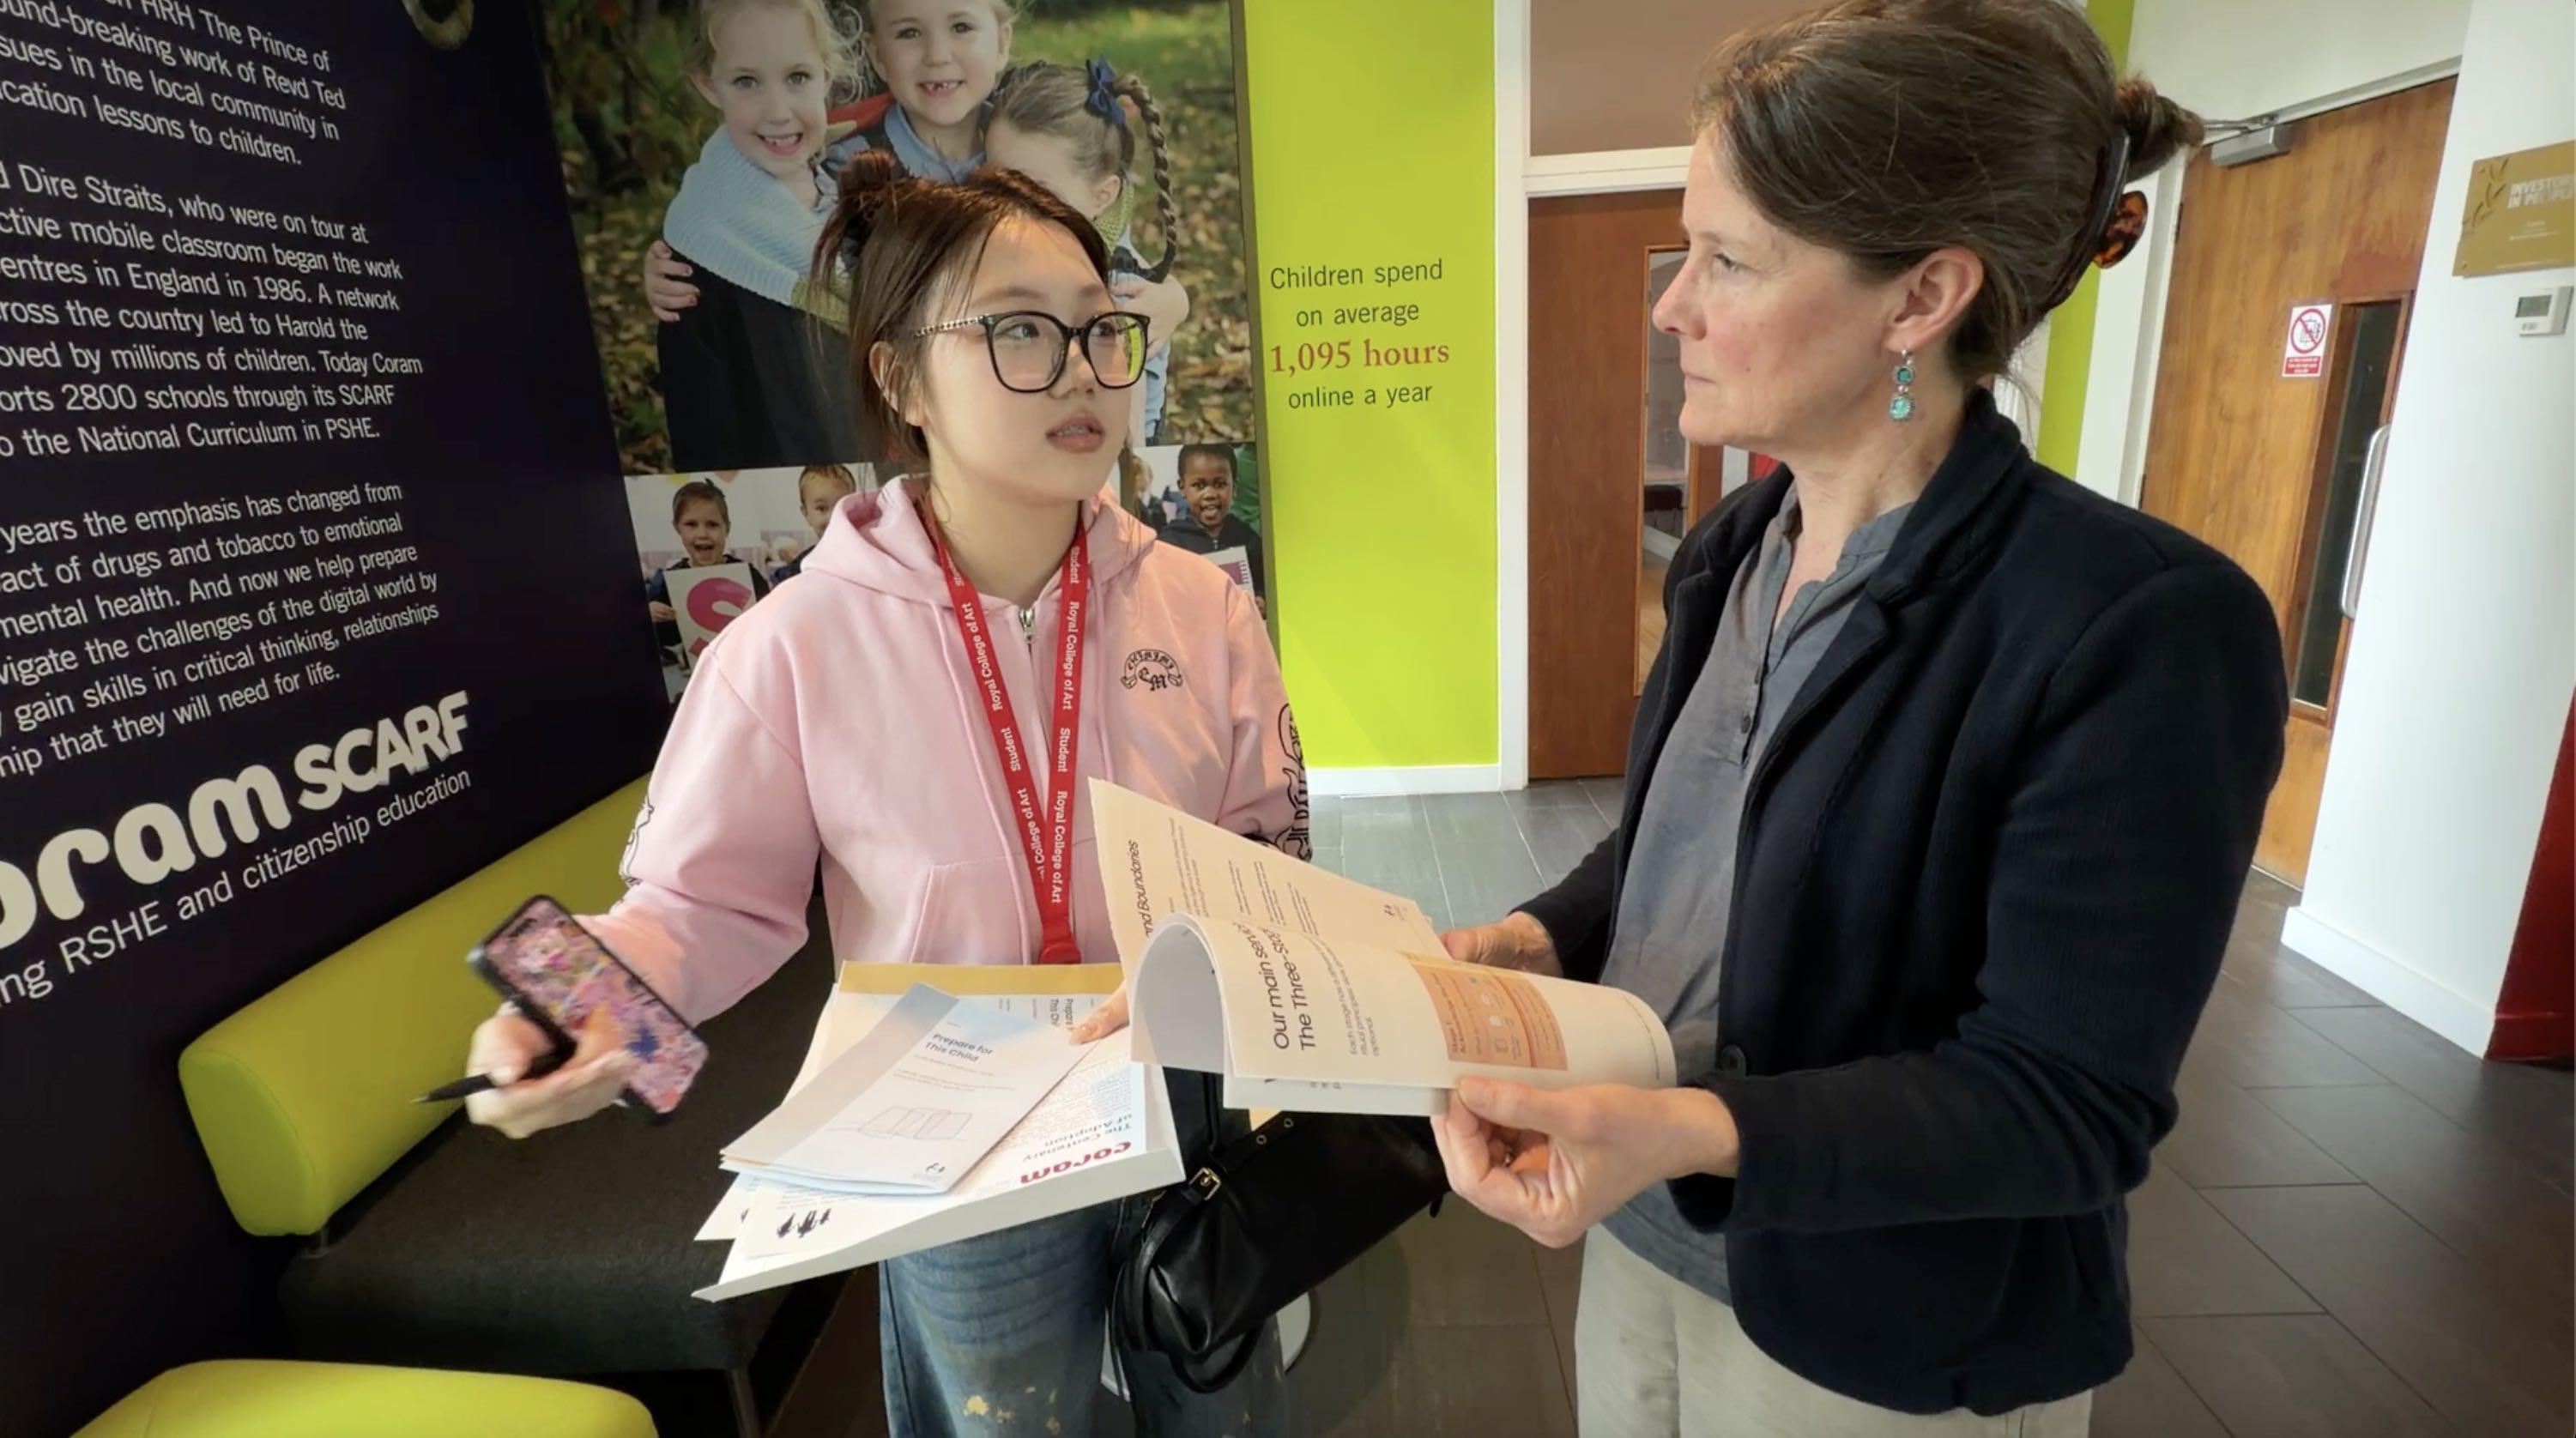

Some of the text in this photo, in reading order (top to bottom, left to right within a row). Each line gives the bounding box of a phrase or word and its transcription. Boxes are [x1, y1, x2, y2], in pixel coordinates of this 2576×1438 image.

[142, 0, 329, 71] HRH The Prince of
[68, 48, 338, 139] in the local community in
[179, 47, 345, 109] work of Revd Ted
[94, 95, 300, 164] lessons to children.
[18, 165, 368, 243] Dire Straits, who were on tour at
[70, 221, 154, 250] mobile
[162, 230, 267, 263] classroom
[272, 244, 328, 273] began
[333, 252, 360, 274] the
[365, 260, 402, 278] work
[94, 260, 119, 286] in
[127, 263, 220, 297] England
[226, 274, 246, 297] in
[254, 276, 311, 302] 1986.
[319, 283, 332, 304] A
[336, 288, 399, 310] network
[1270, 258, 1442, 288] Children spend
[66, 300, 367, 339] the country led to Harold the
[1297, 304, 1419, 327] on average
[69, 342, 100, 374] by
[112, 344, 200, 370] millions
[207, 347, 227, 370] of
[235, 348, 315, 371] children.
[318, 351, 367, 377] Today
[373, 353, 422, 372] Coram
[1270, 338, 1449, 378] 1,095 hours
[62, 384, 136, 410] 2800
[145, 385, 228, 408] schools
[233, 385, 307, 411] through
[312, 385, 336, 406] its
[339, 384, 393, 405] SCARF
[1288, 385, 1432, 408] online a year
[22, 418, 379, 455] the National Curriculum in PSHE.
[0, 483, 402, 553] years the emphasis has changed from
[56, 513, 402, 583] of drugs and tobacco to emotional
[95, 585, 180, 619] health.
[190, 574, 232, 602] And
[239, 571, 278, 592] now
[284, 565, 311, 583] we
[316, 555, 354, 577] help
[360, 547, 417, 573] prepare
[85, 572, 436, 664] the challenges of the digital world by
[962, 601, 976, 624] Art
[966, 622, 978, 633] of
[15, 692, 75, 731] gain
[83, 674, 147, 708] skills
[153, 667, 177, 689] in
[184, 645, 254, 681] critical
[260, 630, 339, 662] thinking,
[344, 605, 438, 640] relationships
[973, 635, 992, 678] College
[50, 662, 339, 759] that they will need for life.
[984, 679, 1003, 711] Royal
[1051, 546, 1080, 904] Student Royal College of Art Student Royal College of Art
[294, 690, 469, 810] SCARF
[1001, 727, 1021, 772] Student
[1017, 788, 1031, 809] Art
[1021, 807, 1033, 819] of
[1028, 820, 1044, 866] College
[59, 771, 469, 973] RSHE and citizenship education
[1128, 839, 1150, 911] Boundaries
[1259, 962, 1290, 1049] Our main
[924, 1042, 979, 1062] This Child
[932, 1032, 993, 1056] Prepare for
[1298, 1013, 1315, 1051] The
[1023, 1122, 1130, 1162] The Centenary
[1044, 1120, 1113, 1146] Adoption
[1020, 1141, 1132, 1184] coram
